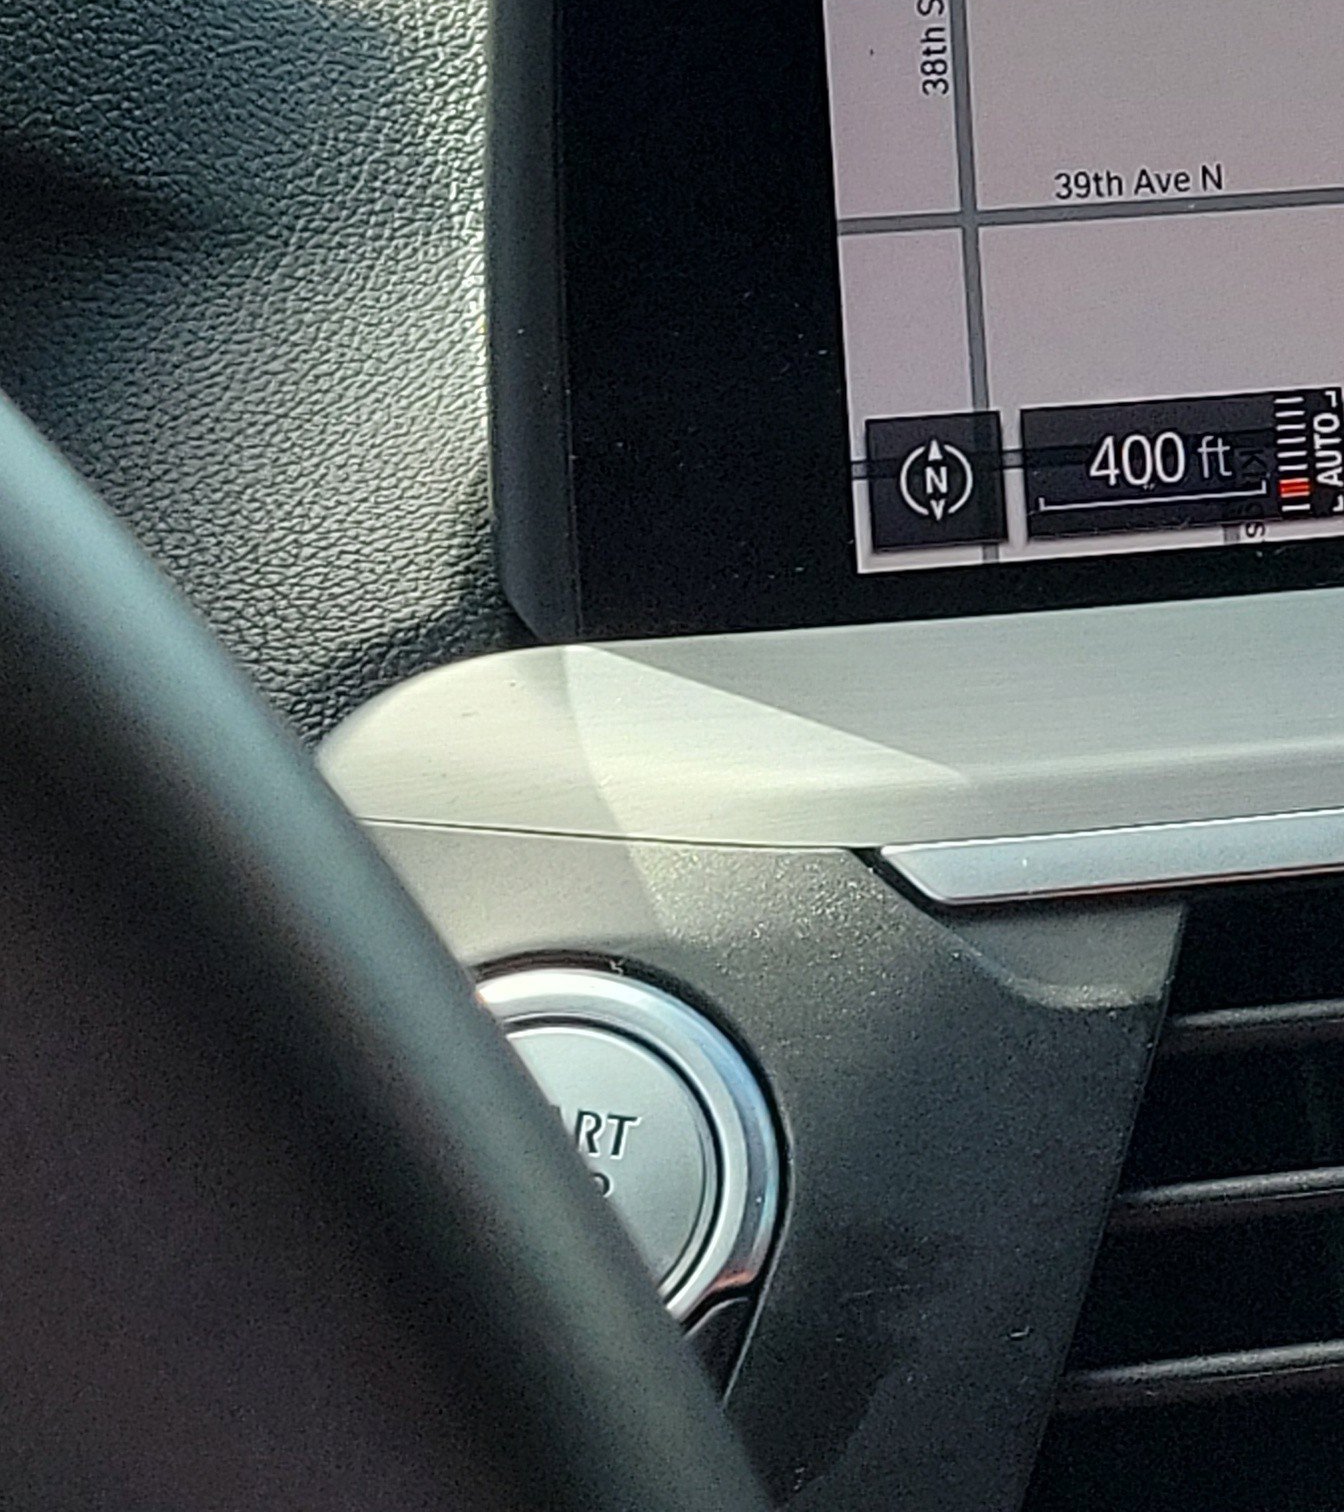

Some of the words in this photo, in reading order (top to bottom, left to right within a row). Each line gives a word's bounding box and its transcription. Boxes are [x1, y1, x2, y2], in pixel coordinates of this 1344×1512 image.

[920, 26, 949, 96] 38th
[1054, 170, 1123, 200] 39th
[1134, 168, 1190, 195] Ave
[1201, 163, 1223, 191] N
[1089, 431, 1186, 486] 400
[1197, 435, 1232, 479] ft
[1313, 412, 1344, 487] AUTO
[925, 466, 948, 494] N
